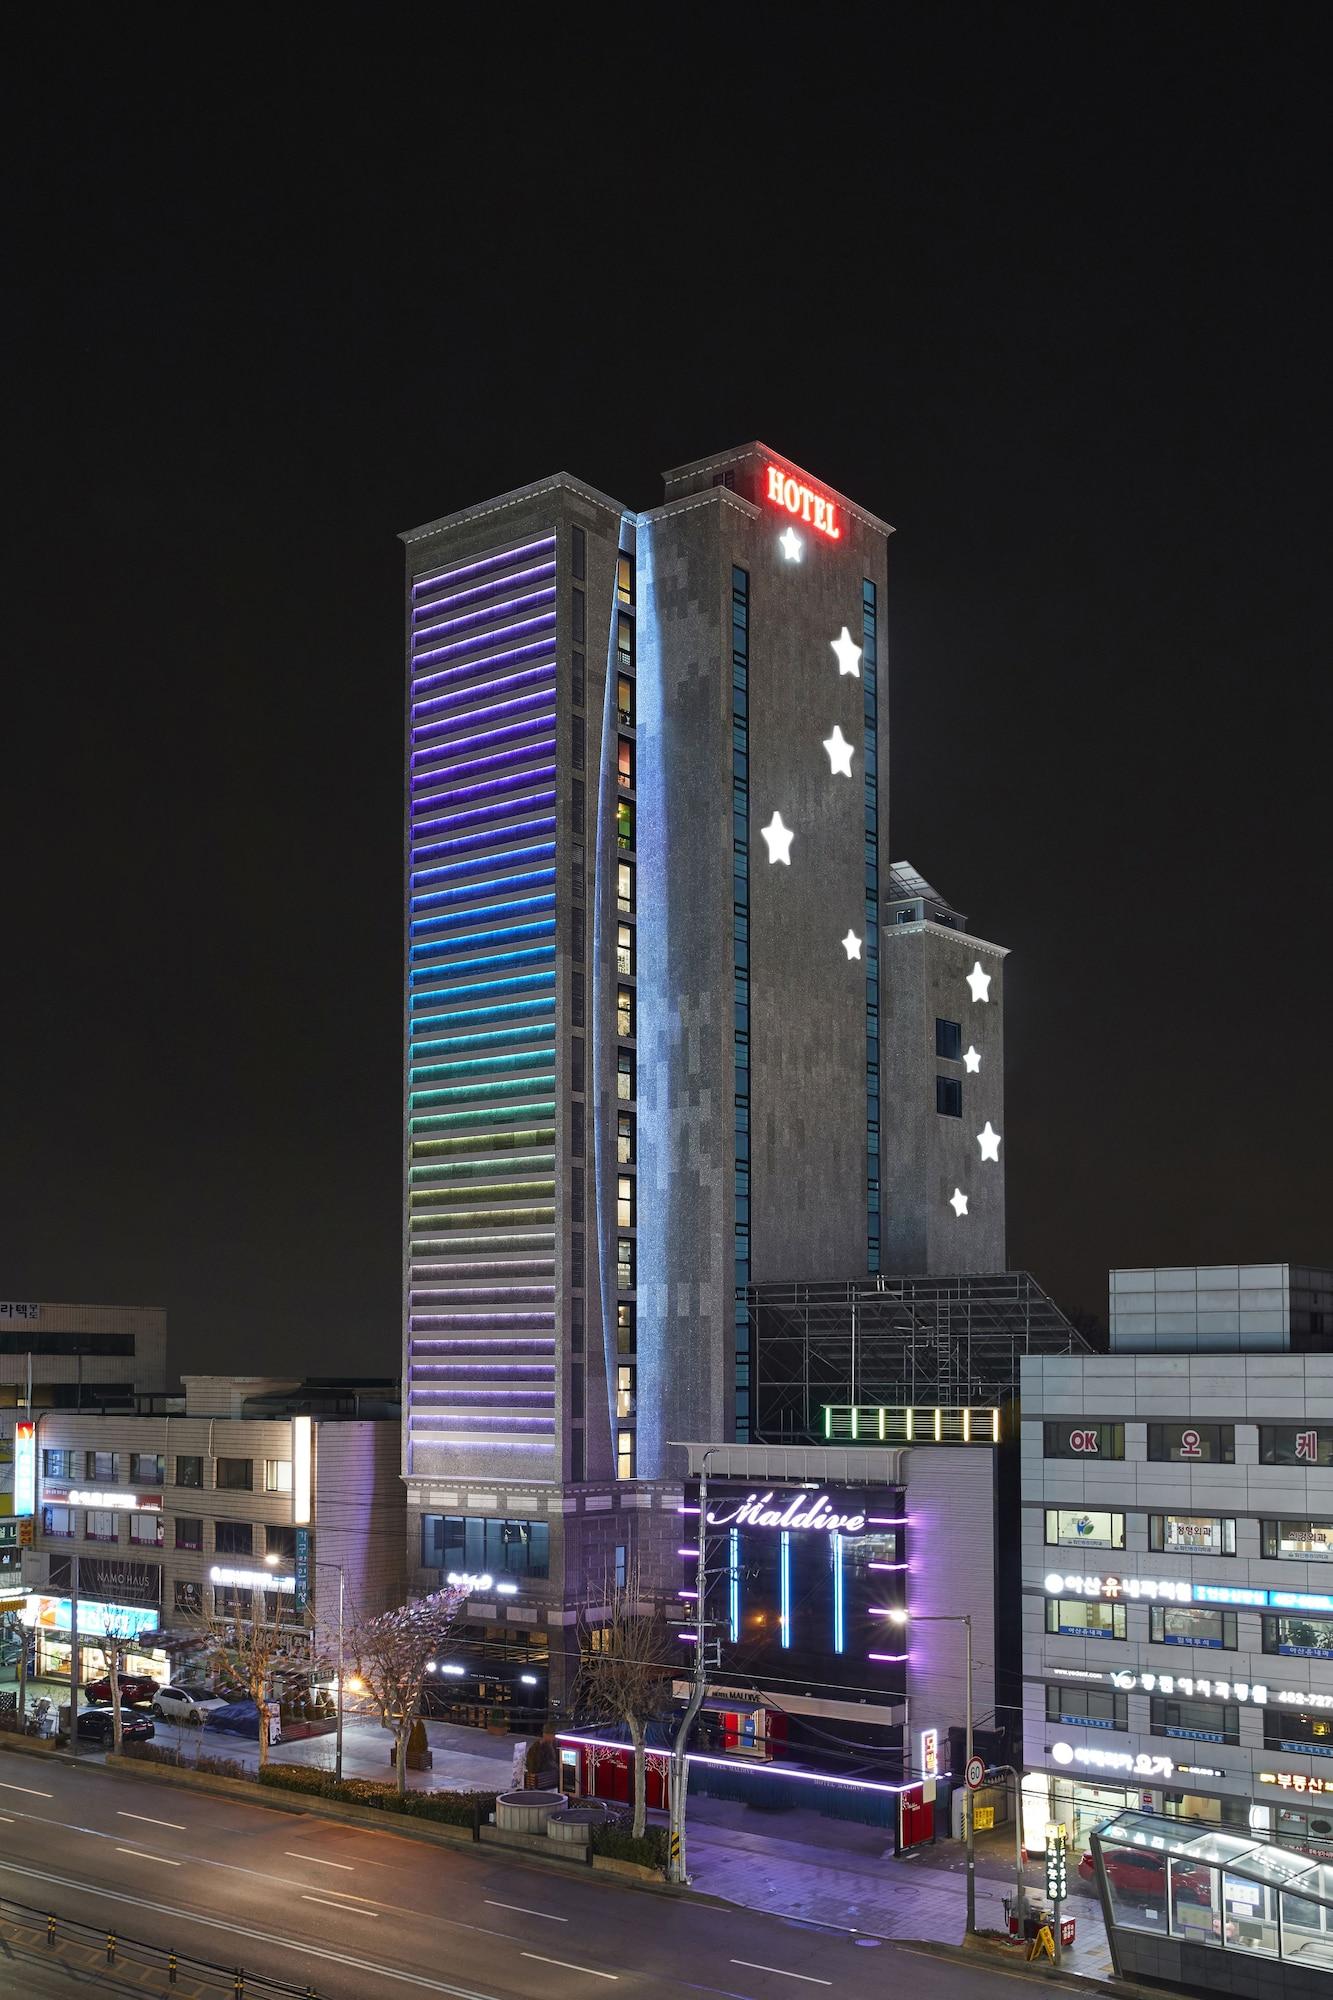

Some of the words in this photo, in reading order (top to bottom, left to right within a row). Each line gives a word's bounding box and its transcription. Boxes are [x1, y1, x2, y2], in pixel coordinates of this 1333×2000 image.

[767, 465, 839, 539] HOTEL
[1070, 1430, 1097, 1452] OK
[1180, 1430, 1201, 1456] 오
[1296, 1431, 1317, 1461] 케
[706, 1491, 865, 1531] Maldive
[126, 1575, 150, 1586] HAUS
[970, 1766, 980, 1780] 60
[1277, 1773, 1323, 1794] 부동산
